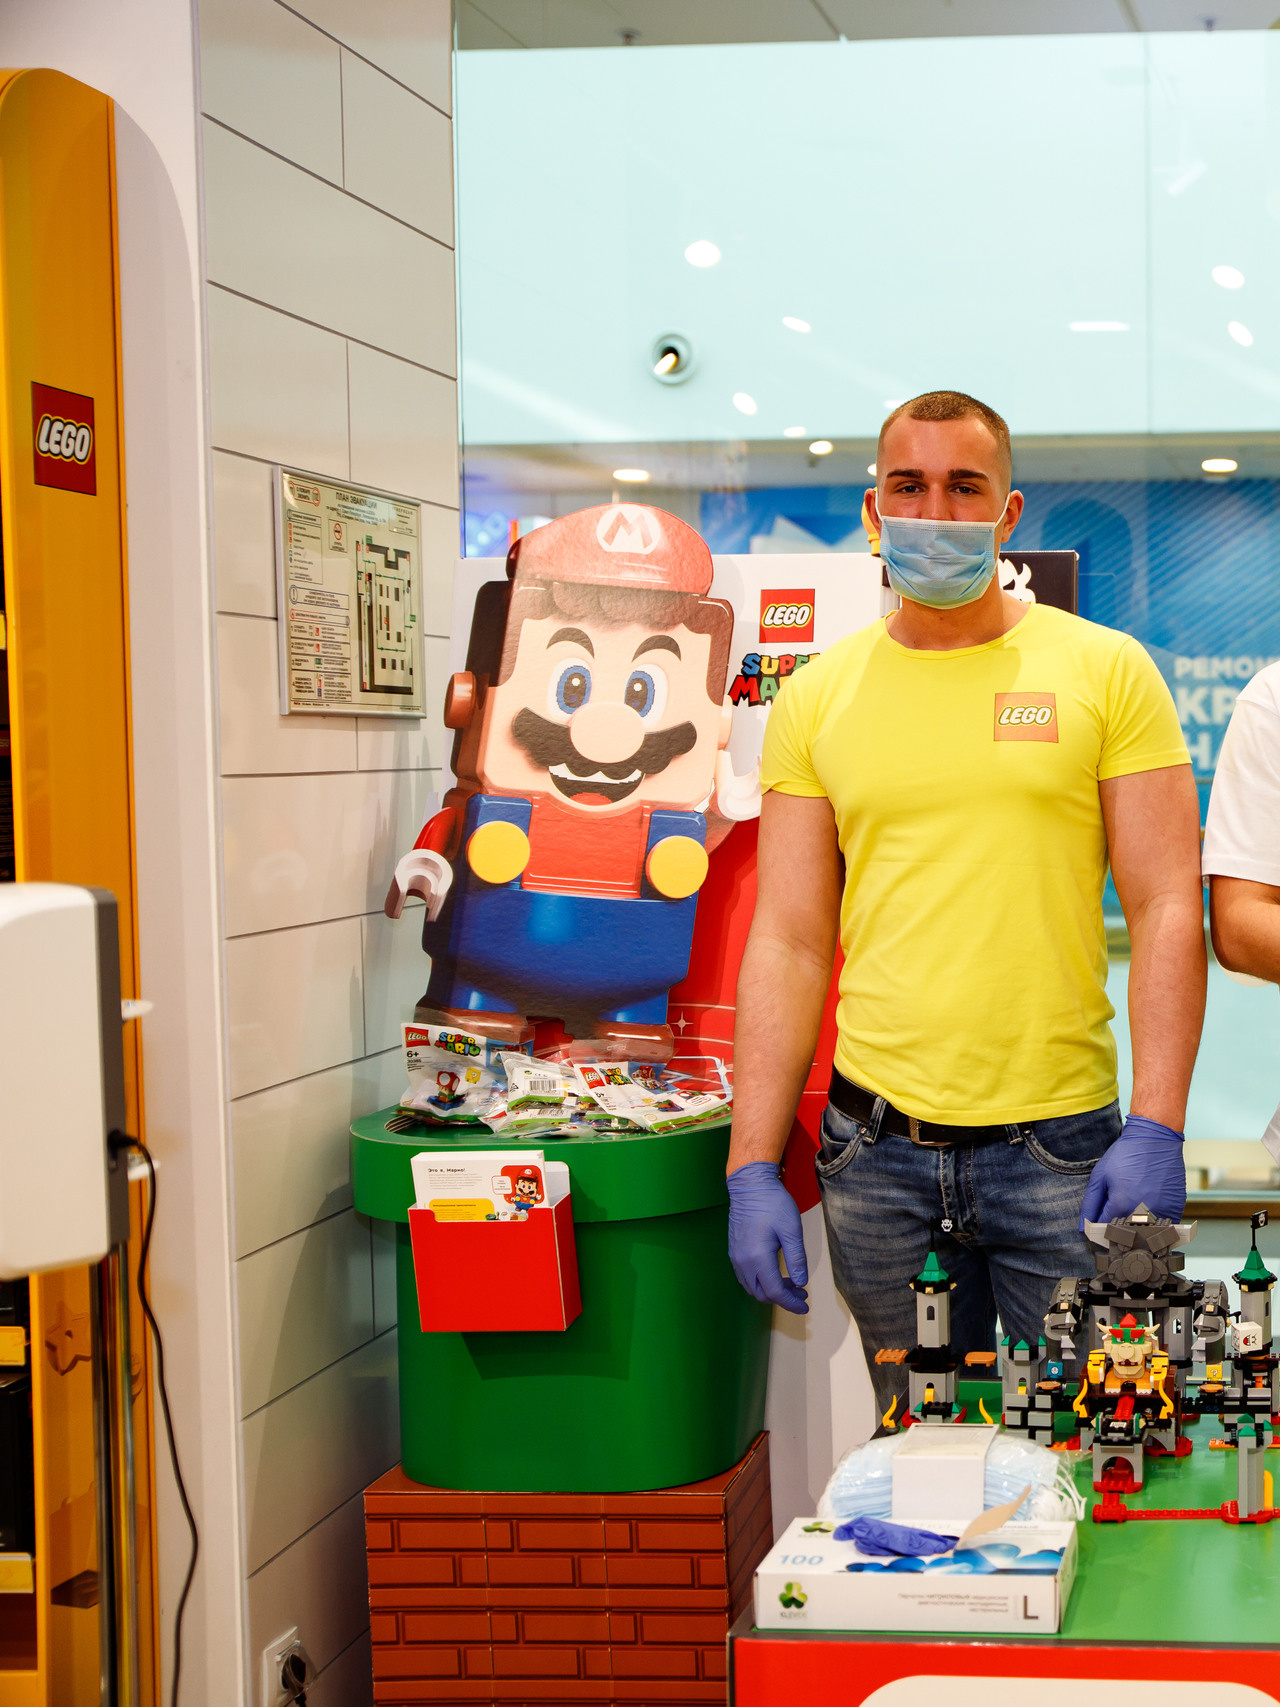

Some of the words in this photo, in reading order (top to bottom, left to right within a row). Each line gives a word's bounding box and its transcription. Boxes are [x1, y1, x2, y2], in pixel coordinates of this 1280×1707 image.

[36, 414, 93, 464] LEGO
[762, 603, 813, 628] LEGO
[998, 703, 1054, 727] LEGO
[407, 1031, 428, 1042] LEGO
[439, 1031, 477, 1046] SUPER
[406, 1050, 420, 1058] 6+
[434, 1040, 481, 1057] MARIO
[584, 1071, 601, 1084] LEGO
[780, 1554, 824, 1566] 100
[1023, 1595, 1039, 1620] L
